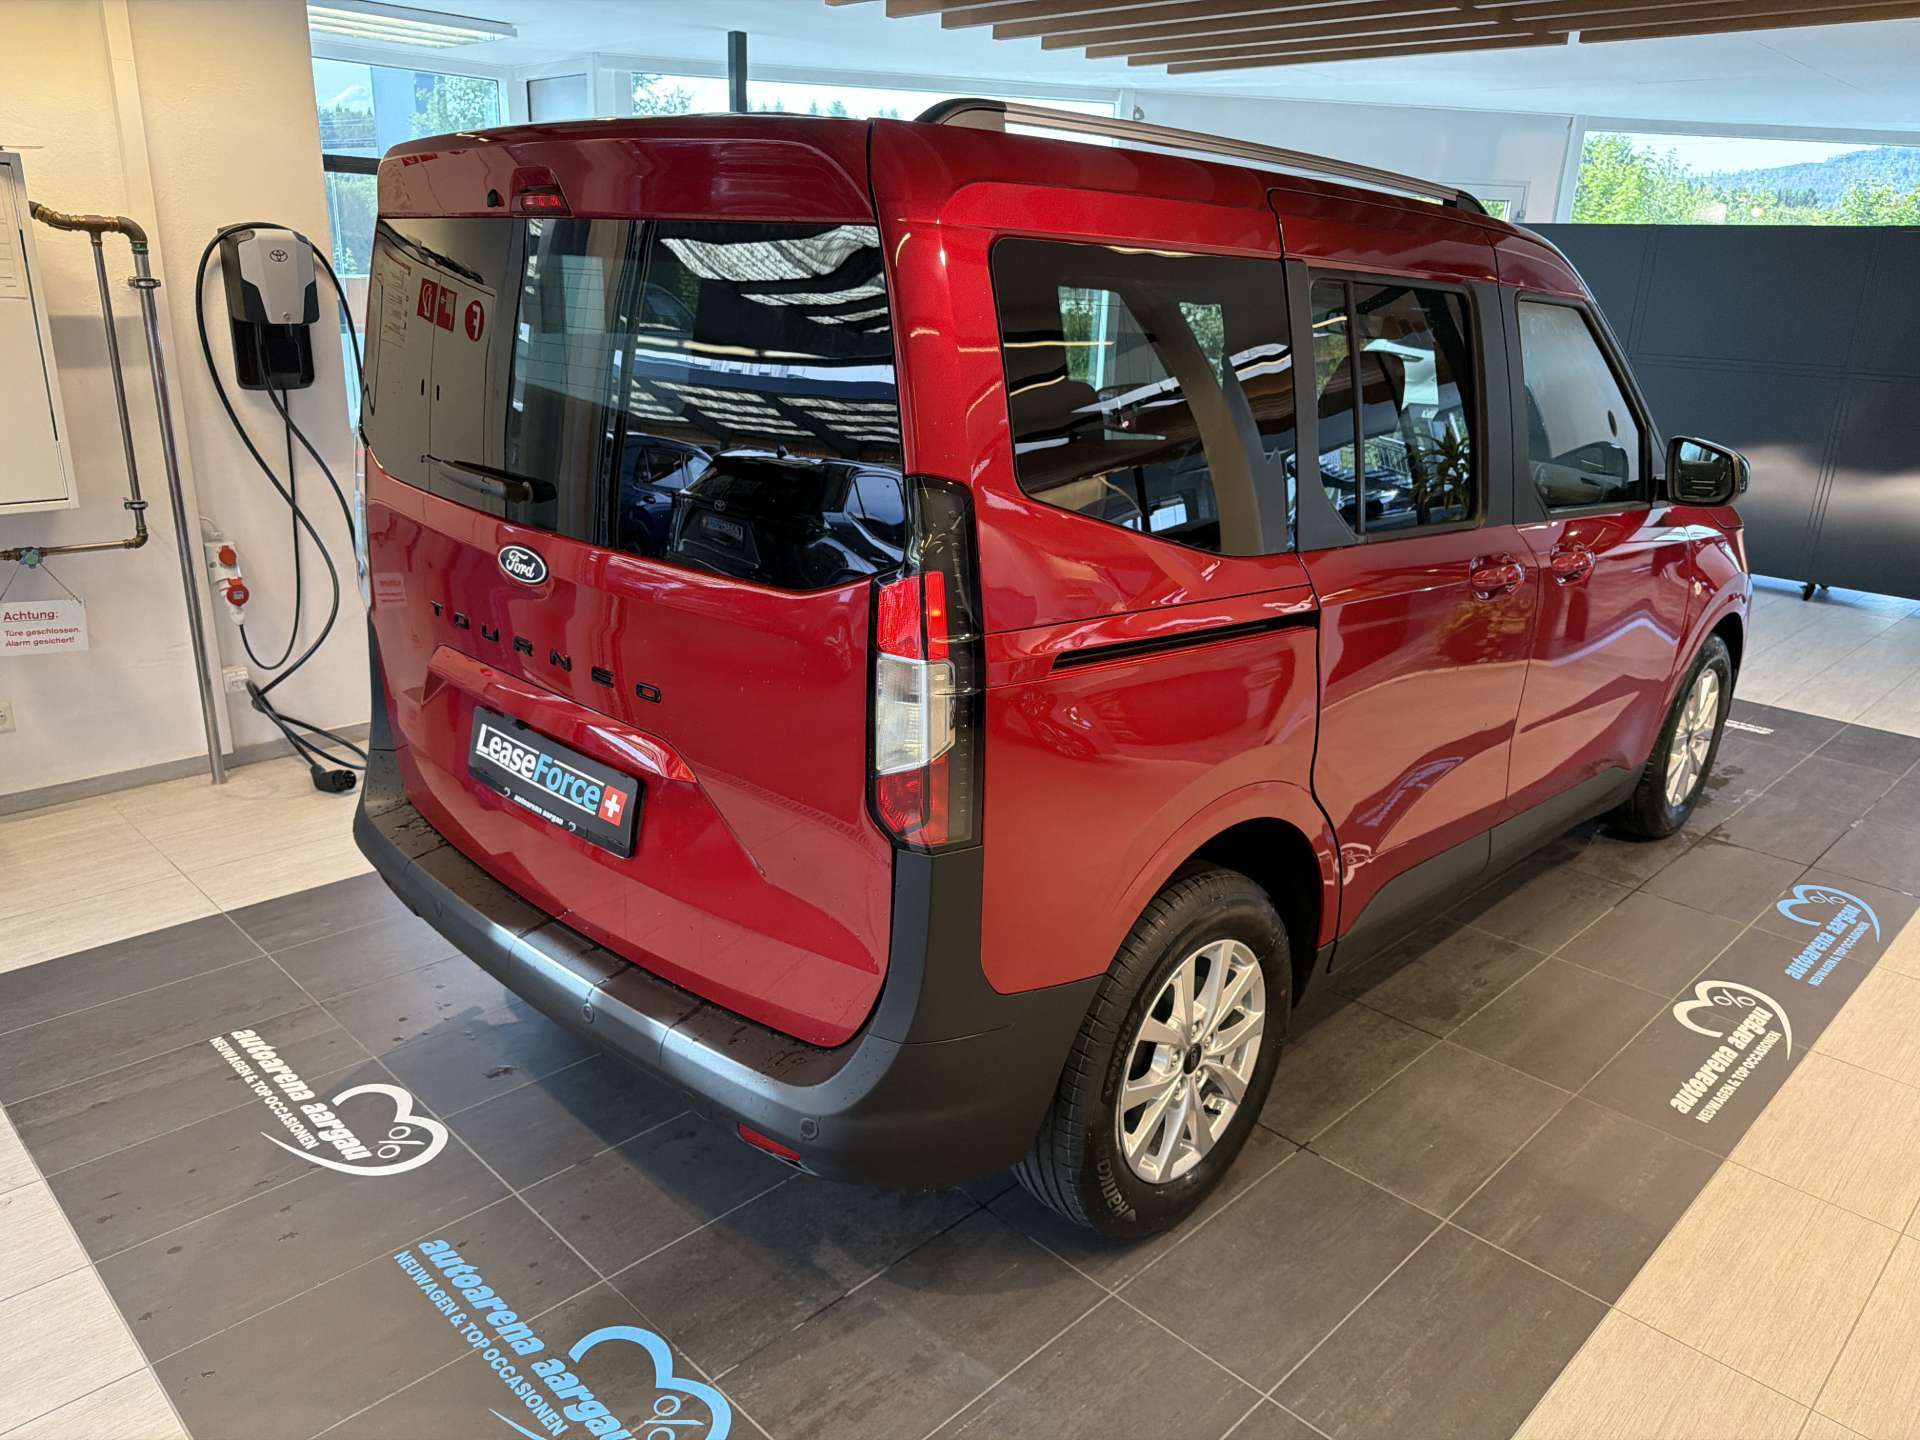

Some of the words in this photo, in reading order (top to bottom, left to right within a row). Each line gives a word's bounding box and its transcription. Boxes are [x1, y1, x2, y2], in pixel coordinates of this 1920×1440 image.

[504, 549, 537, 579] Ford
[3, 611, 59, 621] Achtung:
[6, 639, 31, 647] Alarm
[430, 600, 662, 704] TOURNEO
[476, 723, 601, 812] LeaseForce
[1785, 932, 1836, 980] autoarena
[1825, 904, 1861, 935] aargau
[209, 1037, 254, 1079] NEUWAGEN
[250, 1081, 273, 1099] TOP
[264, 1094, 320, 1150] OCCASIONEN
[231, 1029, 315, 1101] autoarena
[300, 1103, 373, 1160] aargau
[1670, 1045, 1739, 1114] autoarena
[1727, 1006, 1773, 1050] aargau
[1696, 1083, 1737, 1123] NEUWAGEN
[1731, 1066, 1750, 1081] TOP
[1742, 1030, 1782, 1069] OCCASIONEN
[393, 1250, 460, 1317] NEUWAGEN
[451, 1312, 468, 1328] &
[460, 1322, 492, 1349] TOP
[482, 1347, 569, 1437] OCCASIONEN
[418, 1239, 545, 1355] autoarena
